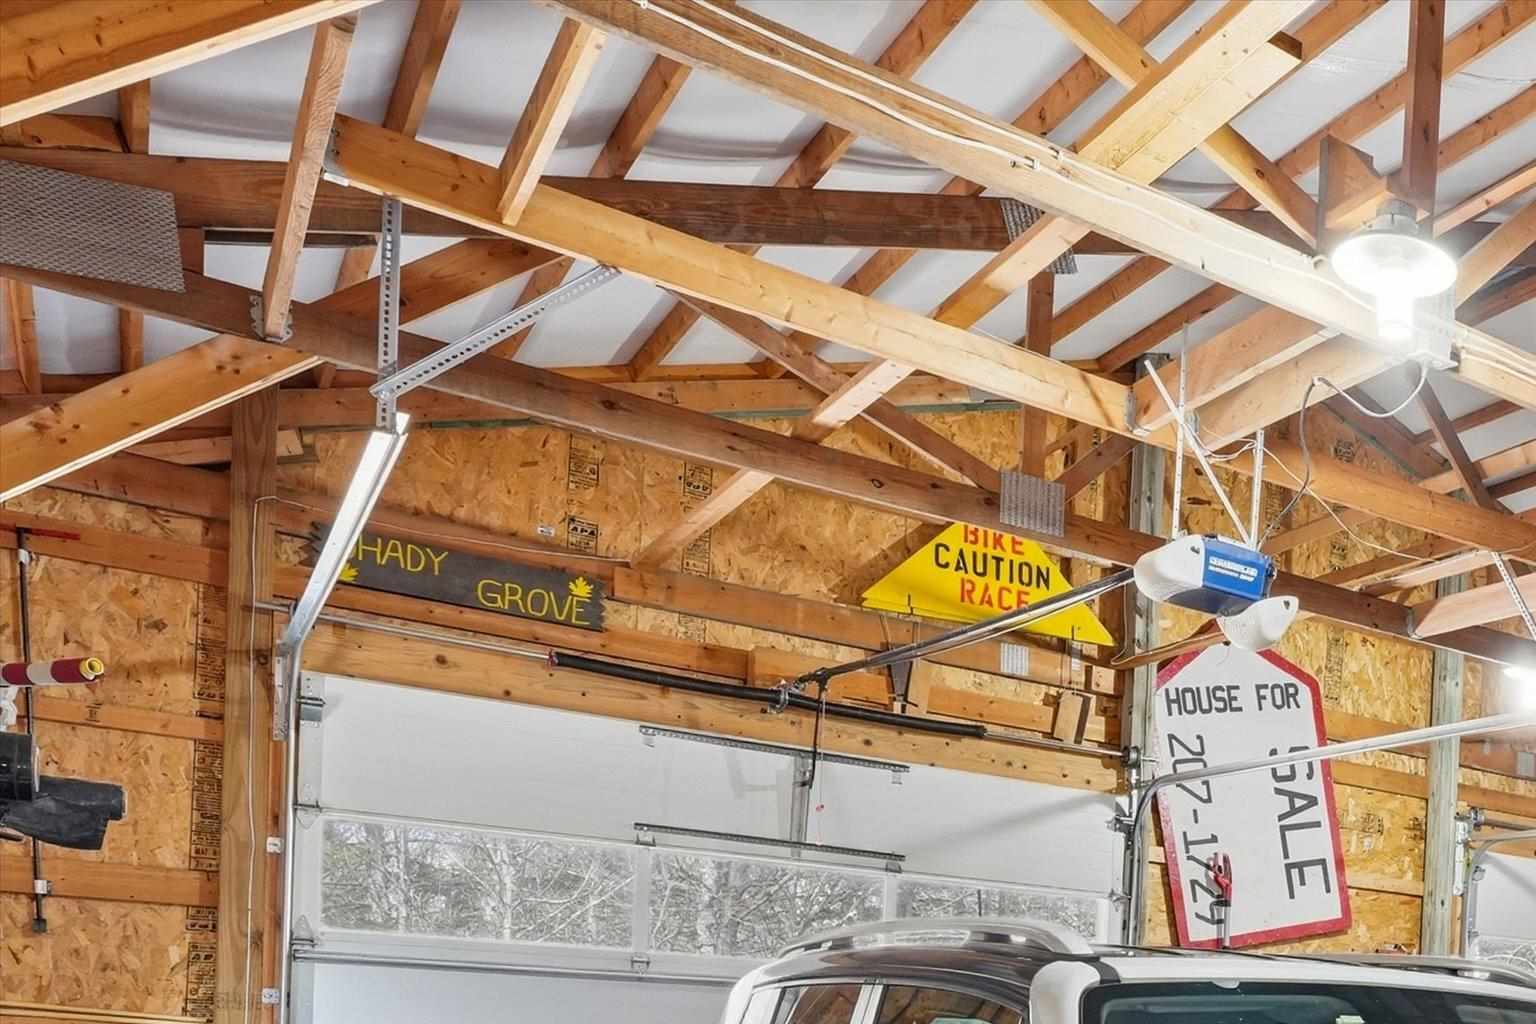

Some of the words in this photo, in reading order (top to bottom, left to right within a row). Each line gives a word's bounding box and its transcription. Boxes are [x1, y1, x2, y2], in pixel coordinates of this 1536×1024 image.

[349, 535, 449, 576] HADY
[963, 524, 1025, 556] BIKE
[934, 542, 1050, 592] CAUTION
[476, 579, 591, 626] GROVE
[959, 578, 1030, 612] RACE
[1164, 684, 1243, 717] HOUSE
[1254, 682, 1301, 712] FOR
[1268, 745, 1332, 900] SALE
